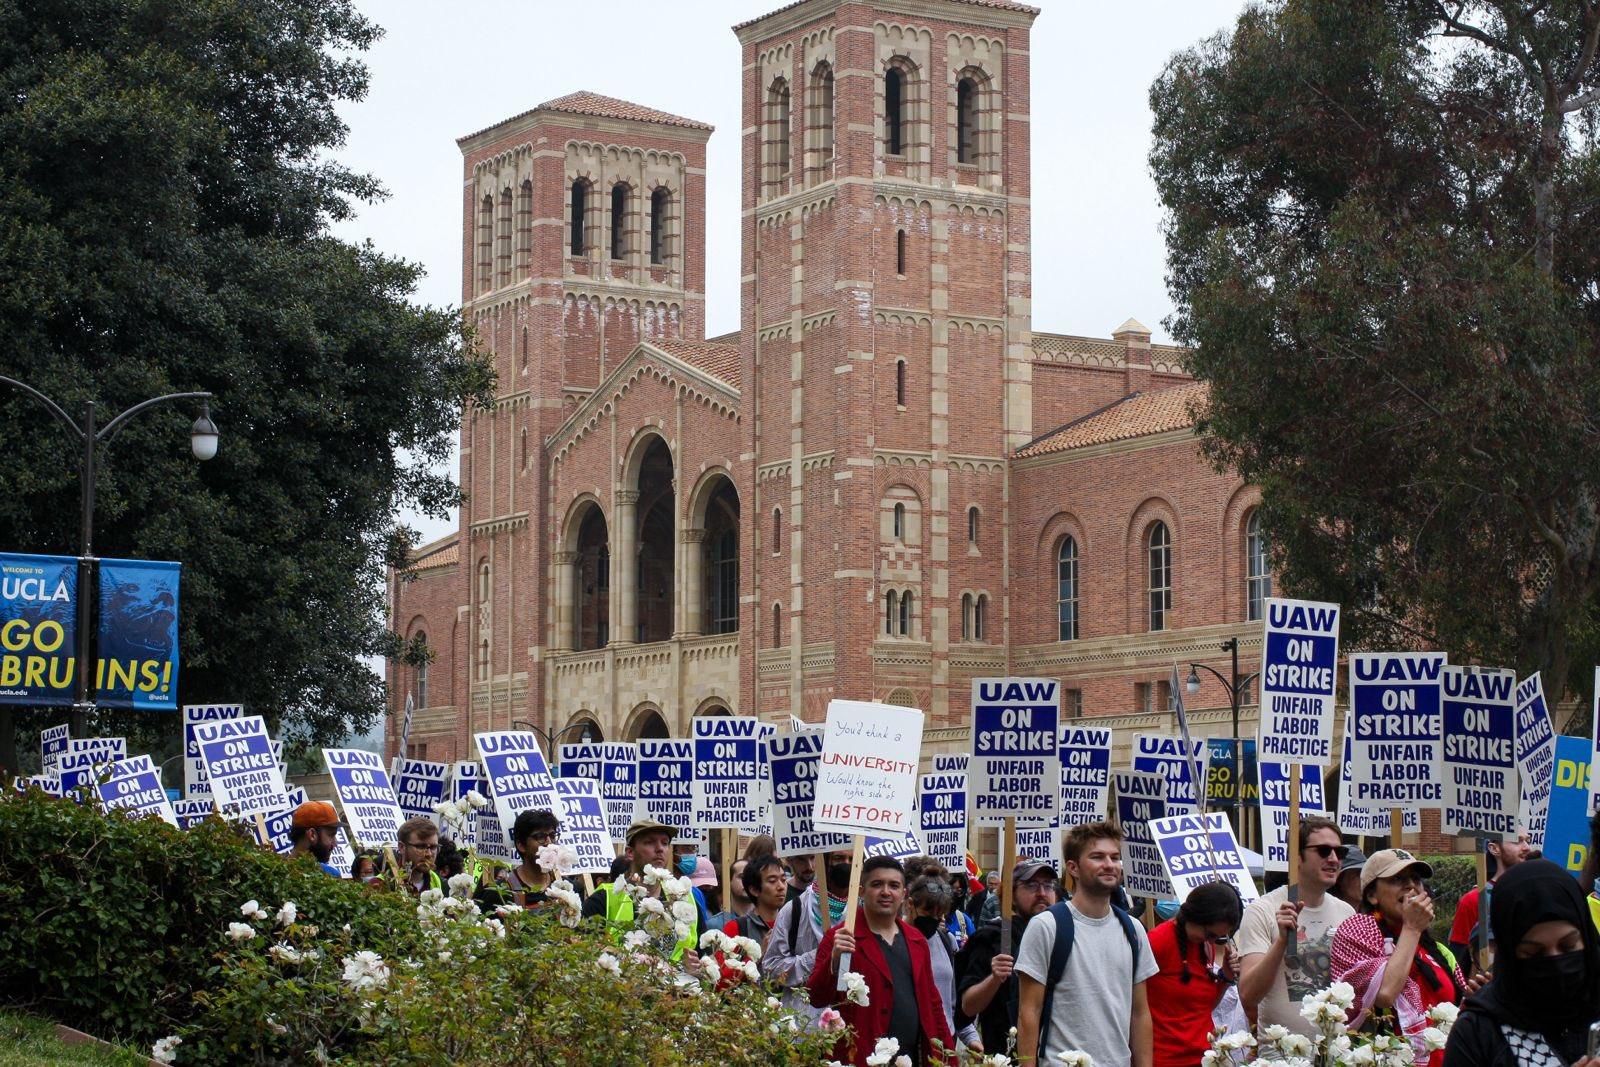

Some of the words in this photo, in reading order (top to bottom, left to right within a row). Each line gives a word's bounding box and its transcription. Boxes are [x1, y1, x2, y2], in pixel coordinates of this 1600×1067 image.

[2, 578, 70, 601] UCLA
[1270, 604, 1337, 632] UAW
[2, 619, 64, 652] GO
[1286, 639, 1313, 662] ON
[1, 655, 75, 688] BRU
[1267, 664, 1332, 690] STRIKE
[1355, 658, 1443, 681] UAW
[980, 683, 1056, 701] UAW
[1444, 672, 1512, 700] UAW
[1516, 677, 1537, 707] AW
[1272, 696, 1322, 716] UNFAIR
[1382, 689, 1416, 711] ON
[189, 707, 240, 720] UAW
[1001, 709, 1032, 728] ON
[1463, 708, 1490, 733] ON
[1521, 705, 1534, 729] ON
[199, 720, 260, 741] UAW
[696, 720, 756, 736] UAW
[835, 721, 863, 737] You'd
[866, 724, 888, 738] think
[1273, 716, 1319, 736] LABOR
[1358, 714, 1440, 736] STRIKE
[43, 727, 67, 741] UAW
[978, 730, 1054, 751] STRIKE
[50, 741, 59, 752] ON
[224, 740, 249, 756] ON
[479, 736, 534, 752] UAW
[714, 743, 737, 758] ON
[1263, 736, 1328, 757] PRACTICE
[1446, 733, 1512, 762] STRIKE
[62, 750, 109, 769] UAW
[328, 752, 378, 767] UAW
[1070, 751, 1091, 766] ON
[1368, 744, 1433, 761] UNFAIR
[1526, 745, 1552, 773] UNFAIR
[212, 753, 273, 775] STRIKE
[506, 757, 529, 772] ON
[578, 763, 598, 776] ON
[658, 764, 681, 778] ON
[697, 761, 755, 776] STRIKE
[823, 752, 915, 774] UNIVERSITY
[936, 757, 968, 771] UAW
[987, 761, 1044, 775] UNFAIR
[351, 770, 374, 784] ON
[615, 766, 628, 780] ON
[1062, 767, 1106, 783] TRIKE
[1208, 767, 1230, 782] GO
[1372, 764, 1430, 780] LABOR
[1454, 767, 1504, 790] UNFAIR
[118, 778, 140, 794] ON
[223, 772, 271, 789] UNFAIR
[407, 779, 427, 793] ON
[495, 773, 552, 792] STRIKE
[556, 781, 593, 794] AW
[641, 781, 692, 795] STRIK
[704, 783, 748, 794] UNFAIR
[827, 772, 854, 783] Would
[856, 774, 874, 786] know
[879, 777, 892, 789] the
[924, 776, 964, 790] UAW
[989, 778, 1040, 793] LABOR
[1117, 775, 1162, 796] UAW
[229, 784, 272, 801] LABOR
[342, 785, 394, 801] STRIKE
[844, 789, 864, 799] right
[886, 791, 895, 800] of
[1358, 783, 1442, 800] PRACTICE
[1457, 788, 1502, 810] LABOR
[400, 793, 439, 808] TRIKE
[508, 794, 552, 809] UNFAIR
[607, 802, 633, 813] UNFAIR
[648, 801, 691, 812] UNFAIR
[706, 796, 746, 808] LABOR
[935, 794, 951, 809] ON
[976, 795, 1053, 809] PRACTICE
[1061, 801, 1095, 812] ABOR
[354, 806, 394, 818] UNFAIR
[697, 810, 756, 822] PRACTICE
[821, 804, 903, 824] HISTORY
[922, 810, 964, 826] STRIKE
[1133, 802, 1151, 819] ON
[361, 819, 397, 830] LABOR
[566, 815, 603, 828] RIKE
[609, 815, 631, 825] LABOR
[1156, 816, 1222, 834] UAW
[1446, 808, 1515, 833] PRACTICE
[357, 831, 398, 842] PRACTI
[927, 832, 958, 843] UNFAIR
[576, 845, 602, 856] BOR
[928, 844, 956, 855] LABOR
[1020, 846, 1049, 858] ABOR
[1132, 861, 1163, 877] LABOR
[1127, 876, 1171, 895] PRACTICE
